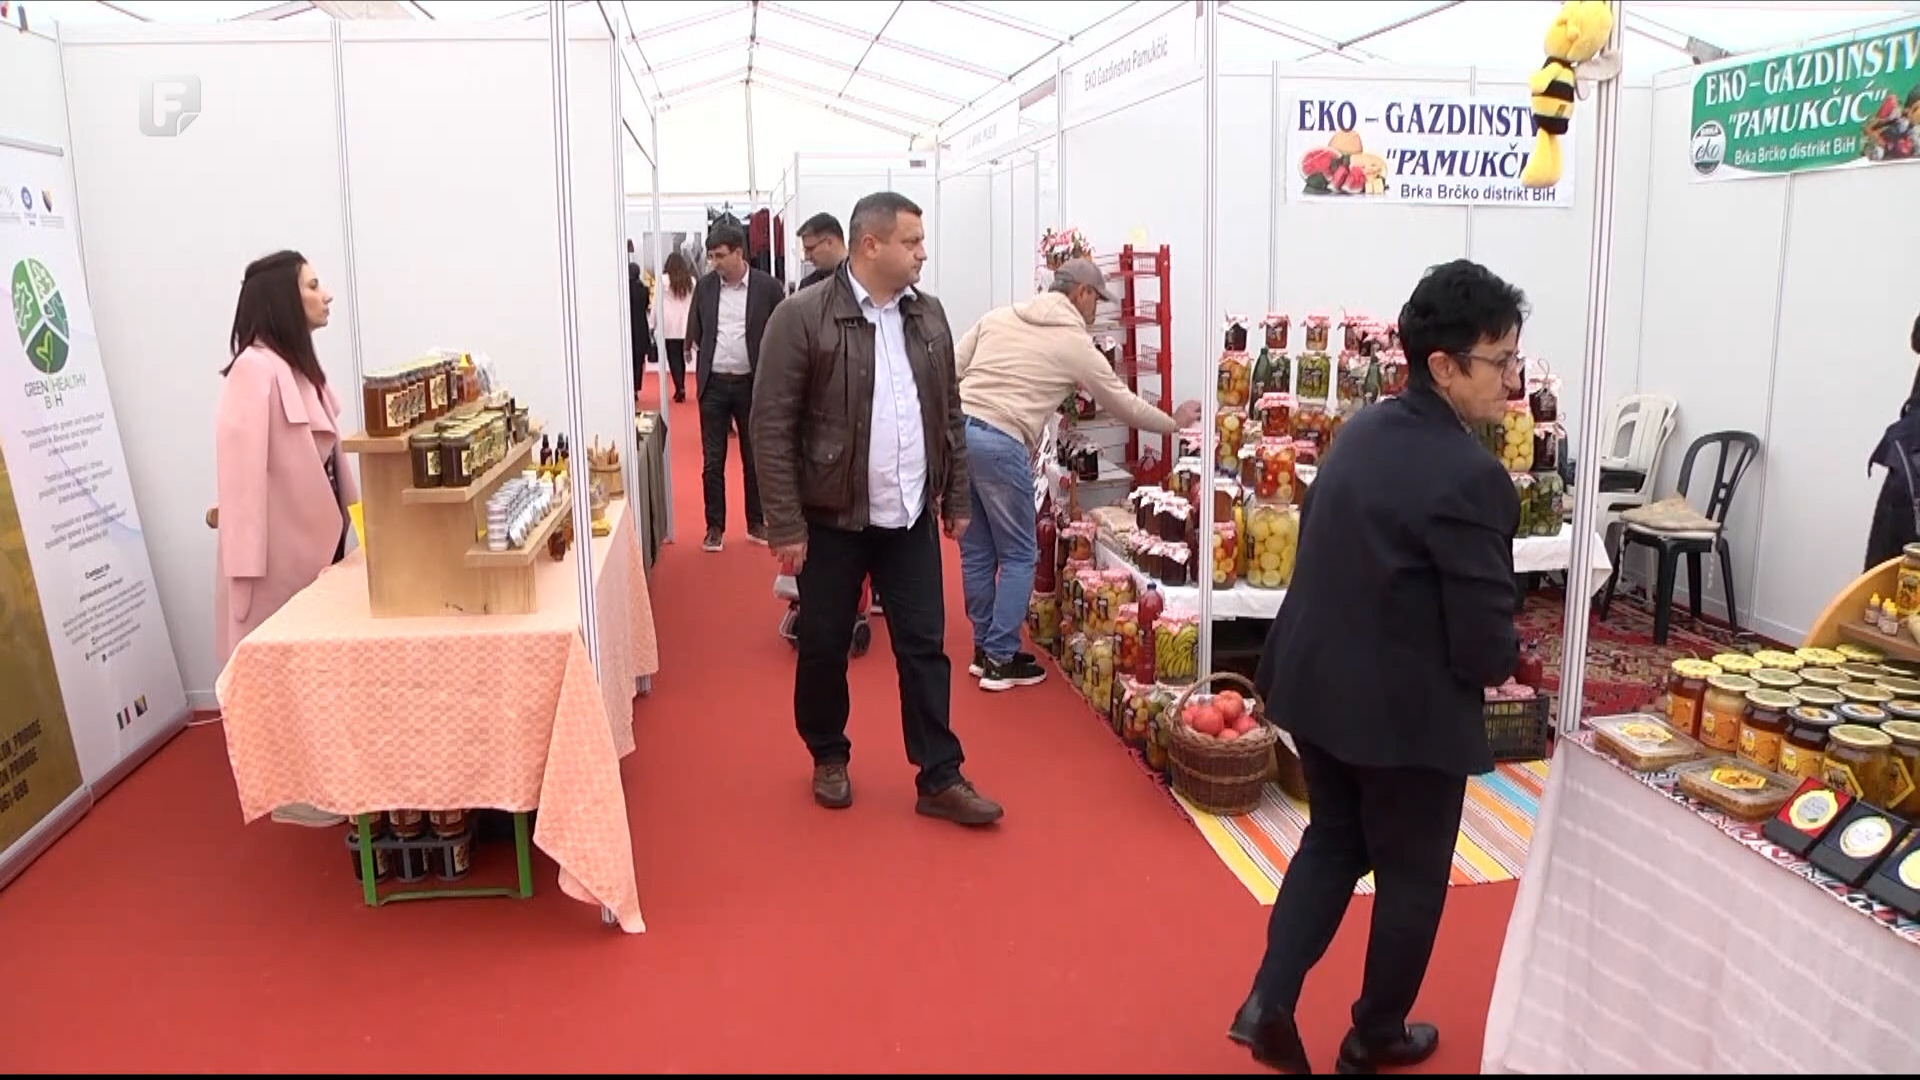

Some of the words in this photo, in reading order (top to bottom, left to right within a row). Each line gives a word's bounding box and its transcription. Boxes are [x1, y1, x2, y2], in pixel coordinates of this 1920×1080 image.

[1084, 70, 1097, 92] EKO
[1705, 69, 1746, 106] EKO
[1298, 99, 1357, 133] EKO
[1385, 102, 1540, 138] GAZDINSTV
[1734, 149, 1757, 165] Brka
[1757, 146, 1787, 163] Brčko
[1788, 140, 1832, 158] distrikt
[1833, 136, 1856, 153] BiH
[1401, 183, 1432, 199] Brka
[1437, 183, 1479, 200] Brčko
[1482, 184, 1529, 201] distrikt
[1533, 187, 1556, 202] BiH
